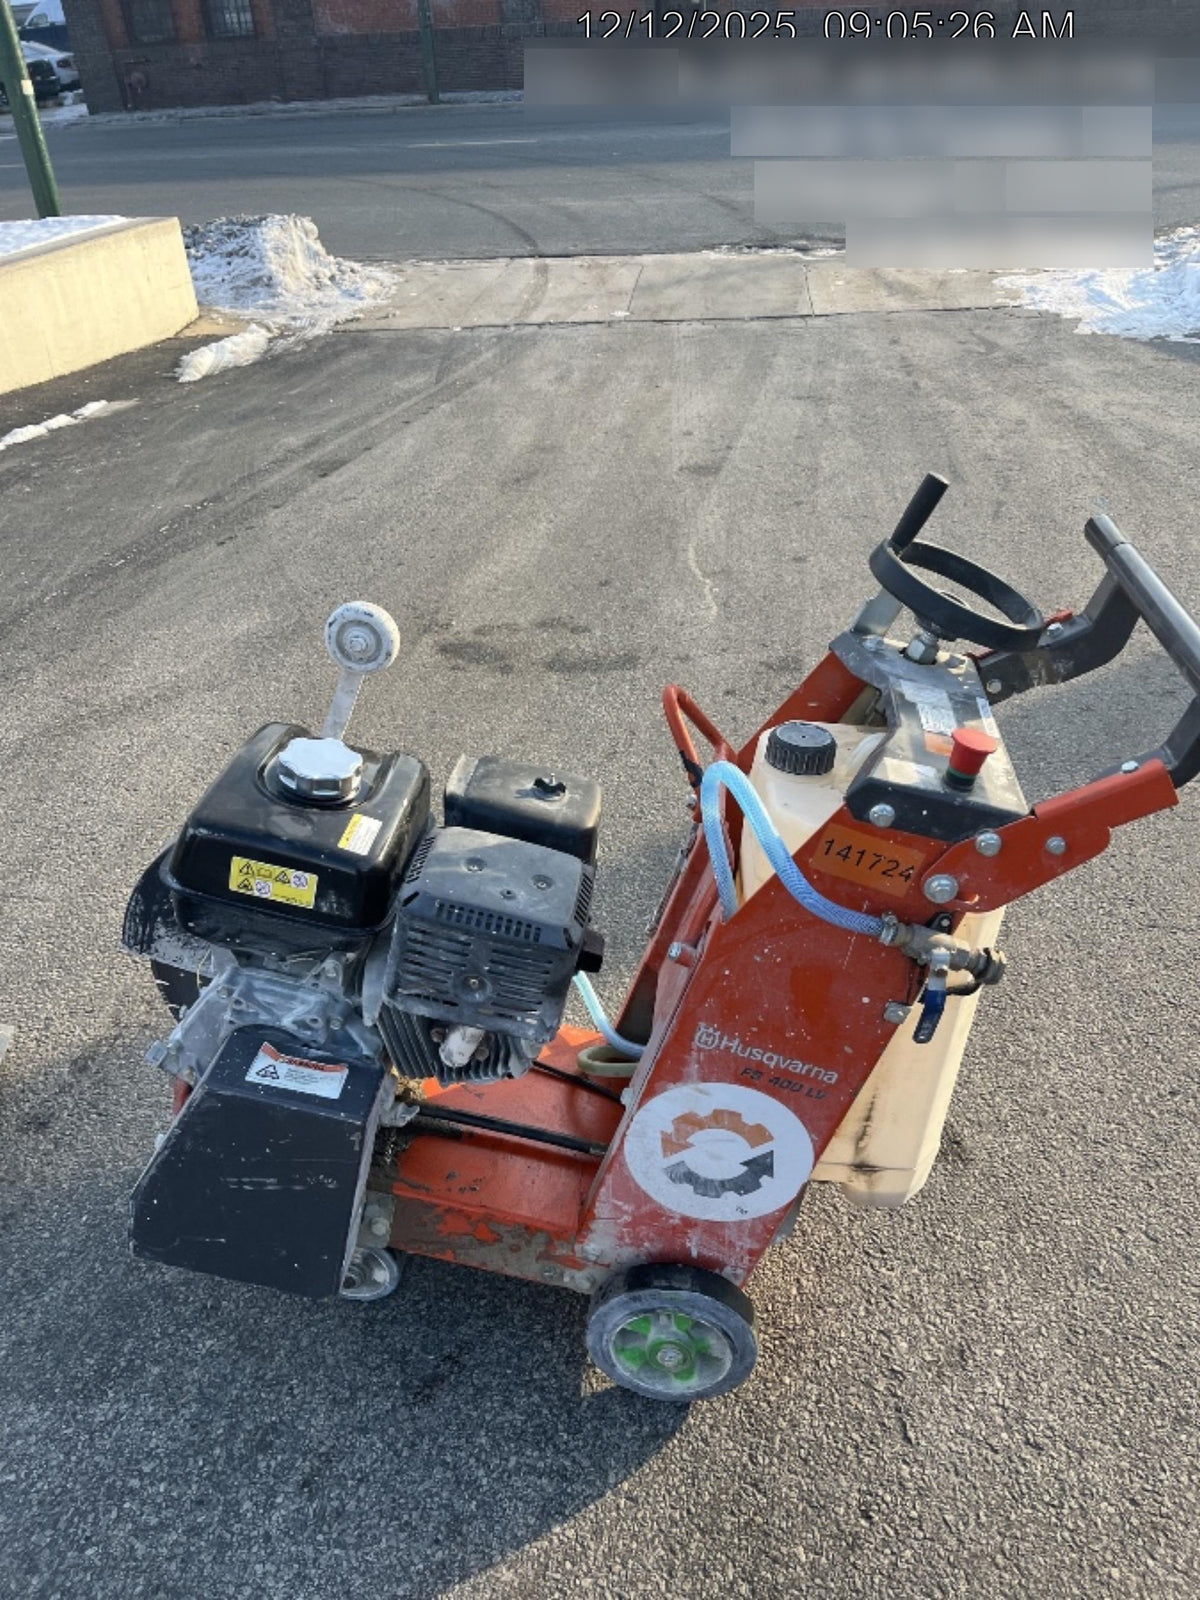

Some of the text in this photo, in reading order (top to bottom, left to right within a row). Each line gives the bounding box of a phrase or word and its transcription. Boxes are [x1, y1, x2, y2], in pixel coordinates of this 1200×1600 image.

[823, 837, 915, 883] 141724
[719, 1035, 838, 1084] Husqvarna
[768, 1075, 804, 1093] 400
